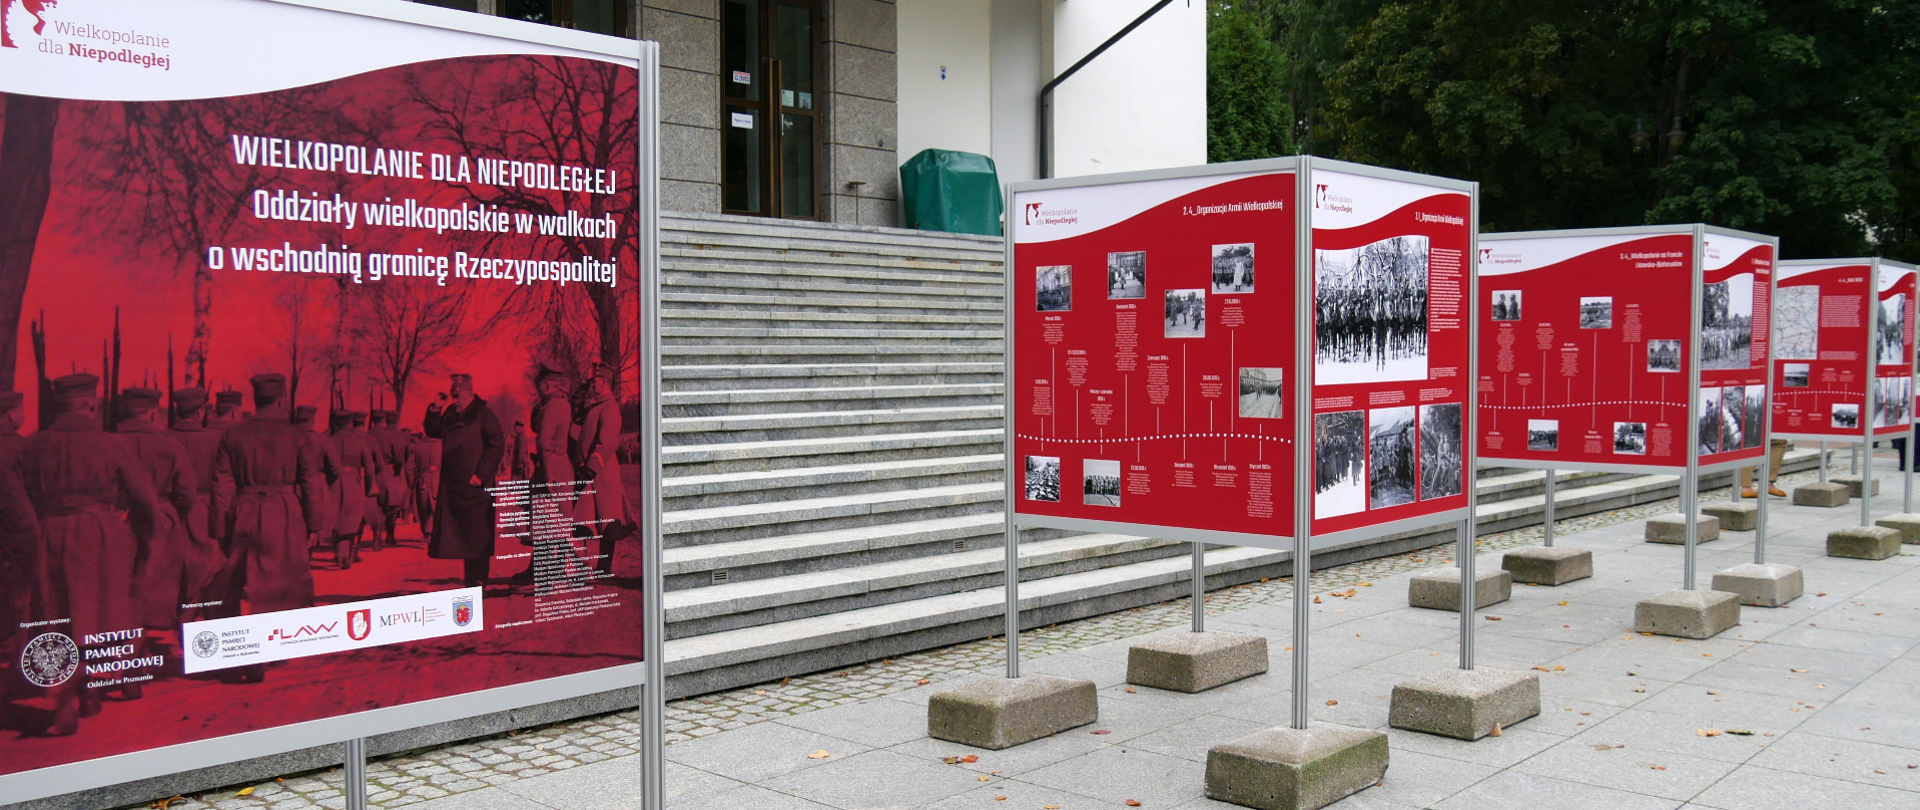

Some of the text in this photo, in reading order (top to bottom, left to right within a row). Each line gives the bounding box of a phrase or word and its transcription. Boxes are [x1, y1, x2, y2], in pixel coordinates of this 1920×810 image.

[54, 20, 170, 48] Wielkopolanie
[38, 39, 170, 71] dla Niepodległej
[232, 134, 617, 195] WIELKOPOLANIE DLA NIEPODLEGŁEJ
[254, 188, 617, 239] Oddziały wielkopolskie w walkach
[1228, 202, 1243, 212] Armii
[1243, 199, 1283, 212] Wielkopolskiej
[208, 242, 617, 288] o wschodnią granicę Rzeczypospolitej
[379, 610, 422, 628] MPWL
[84, 627, 144, 645] INSTYTUT
[221, 628, 250, 637] INSTYTUT
[280, 620, 339, 639] LAW
[221, 636, 246, 645] PAMIĘCI
[222, 642, 260, 652] NARODOWEJ
[85, 644, 134, 660] PAMIĘCI
[86, 655, 164, 675] NARODOWEJ
[123, 673, 154, 684] Poznaniu
